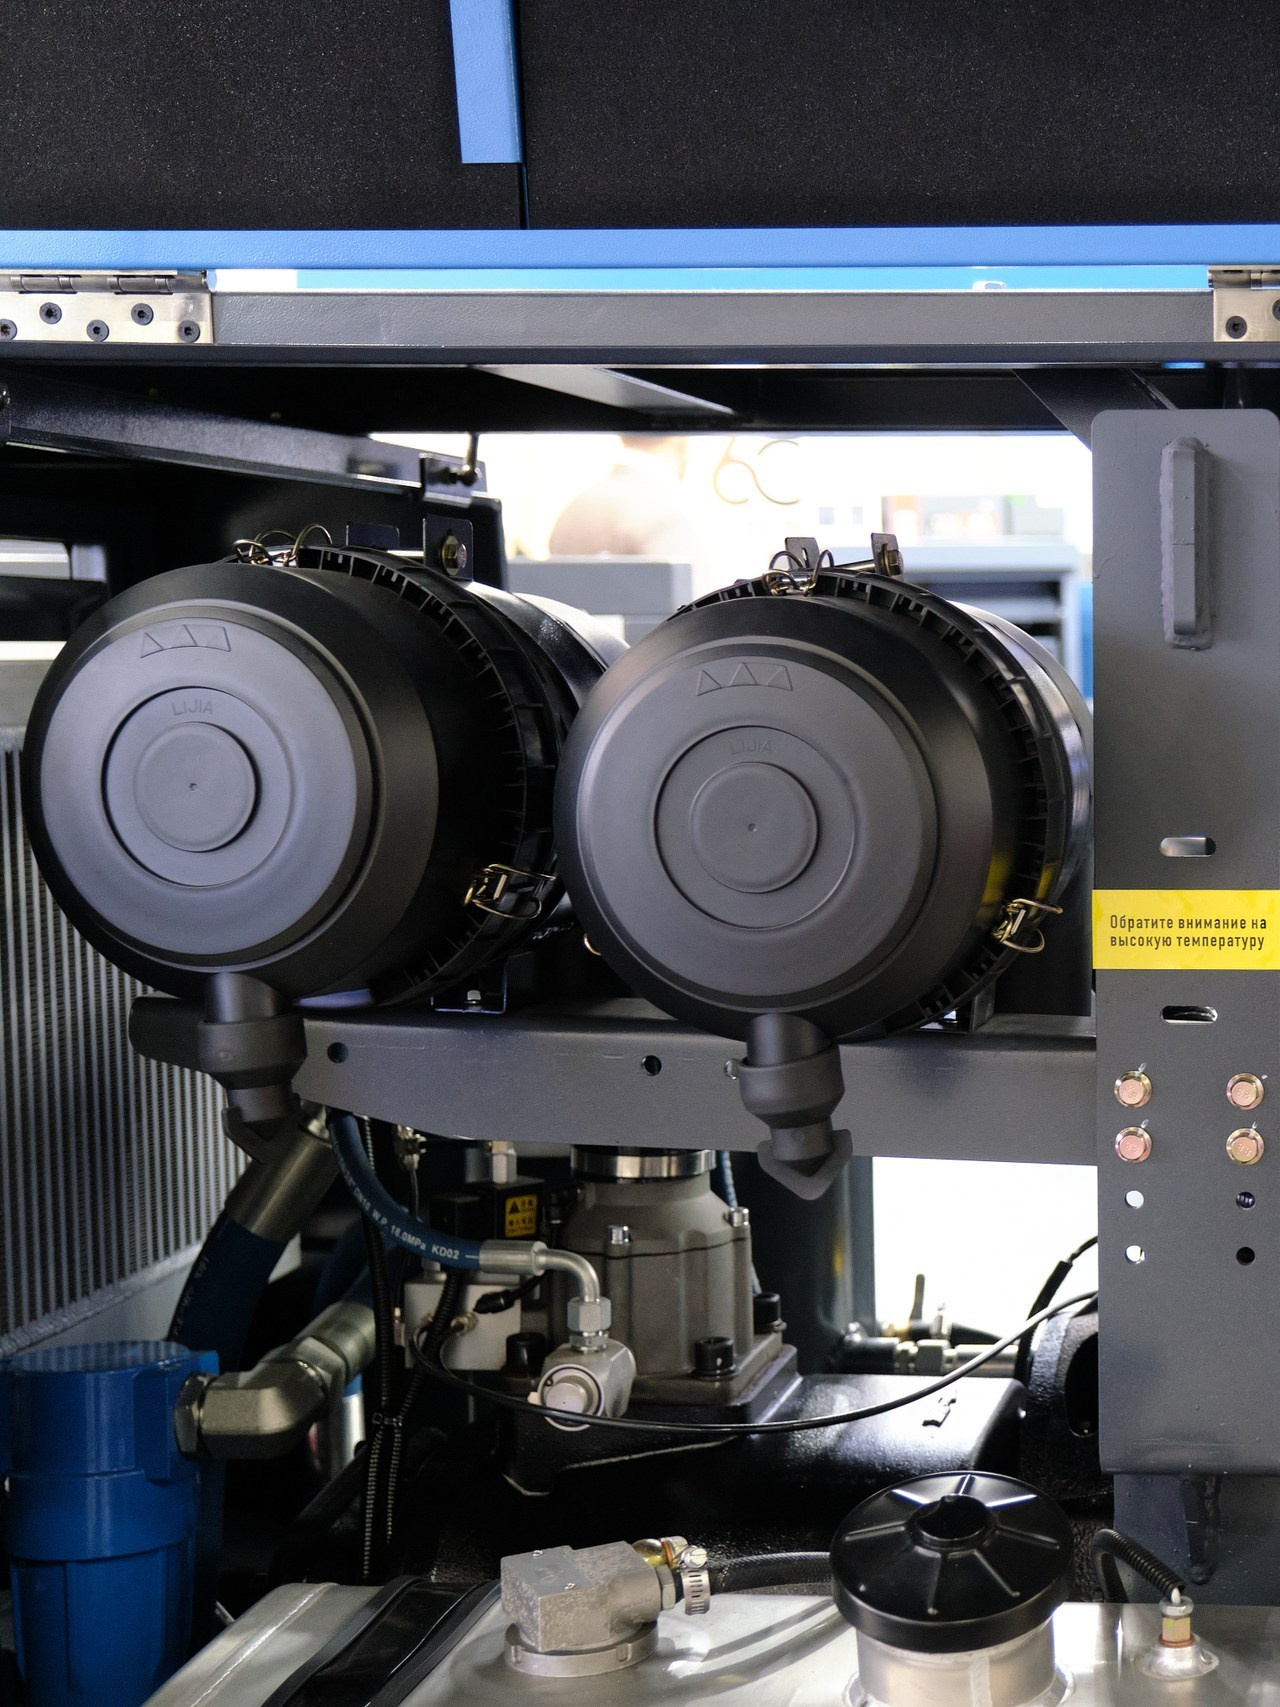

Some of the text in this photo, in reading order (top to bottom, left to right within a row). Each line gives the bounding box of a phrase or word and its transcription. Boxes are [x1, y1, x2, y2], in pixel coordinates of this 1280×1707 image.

[1110, 915, 1267, 932] Обратите внимание на
[1110, 936, 1265, 950] высокую температуру
[431, 1244, 460, 1260] KD02
